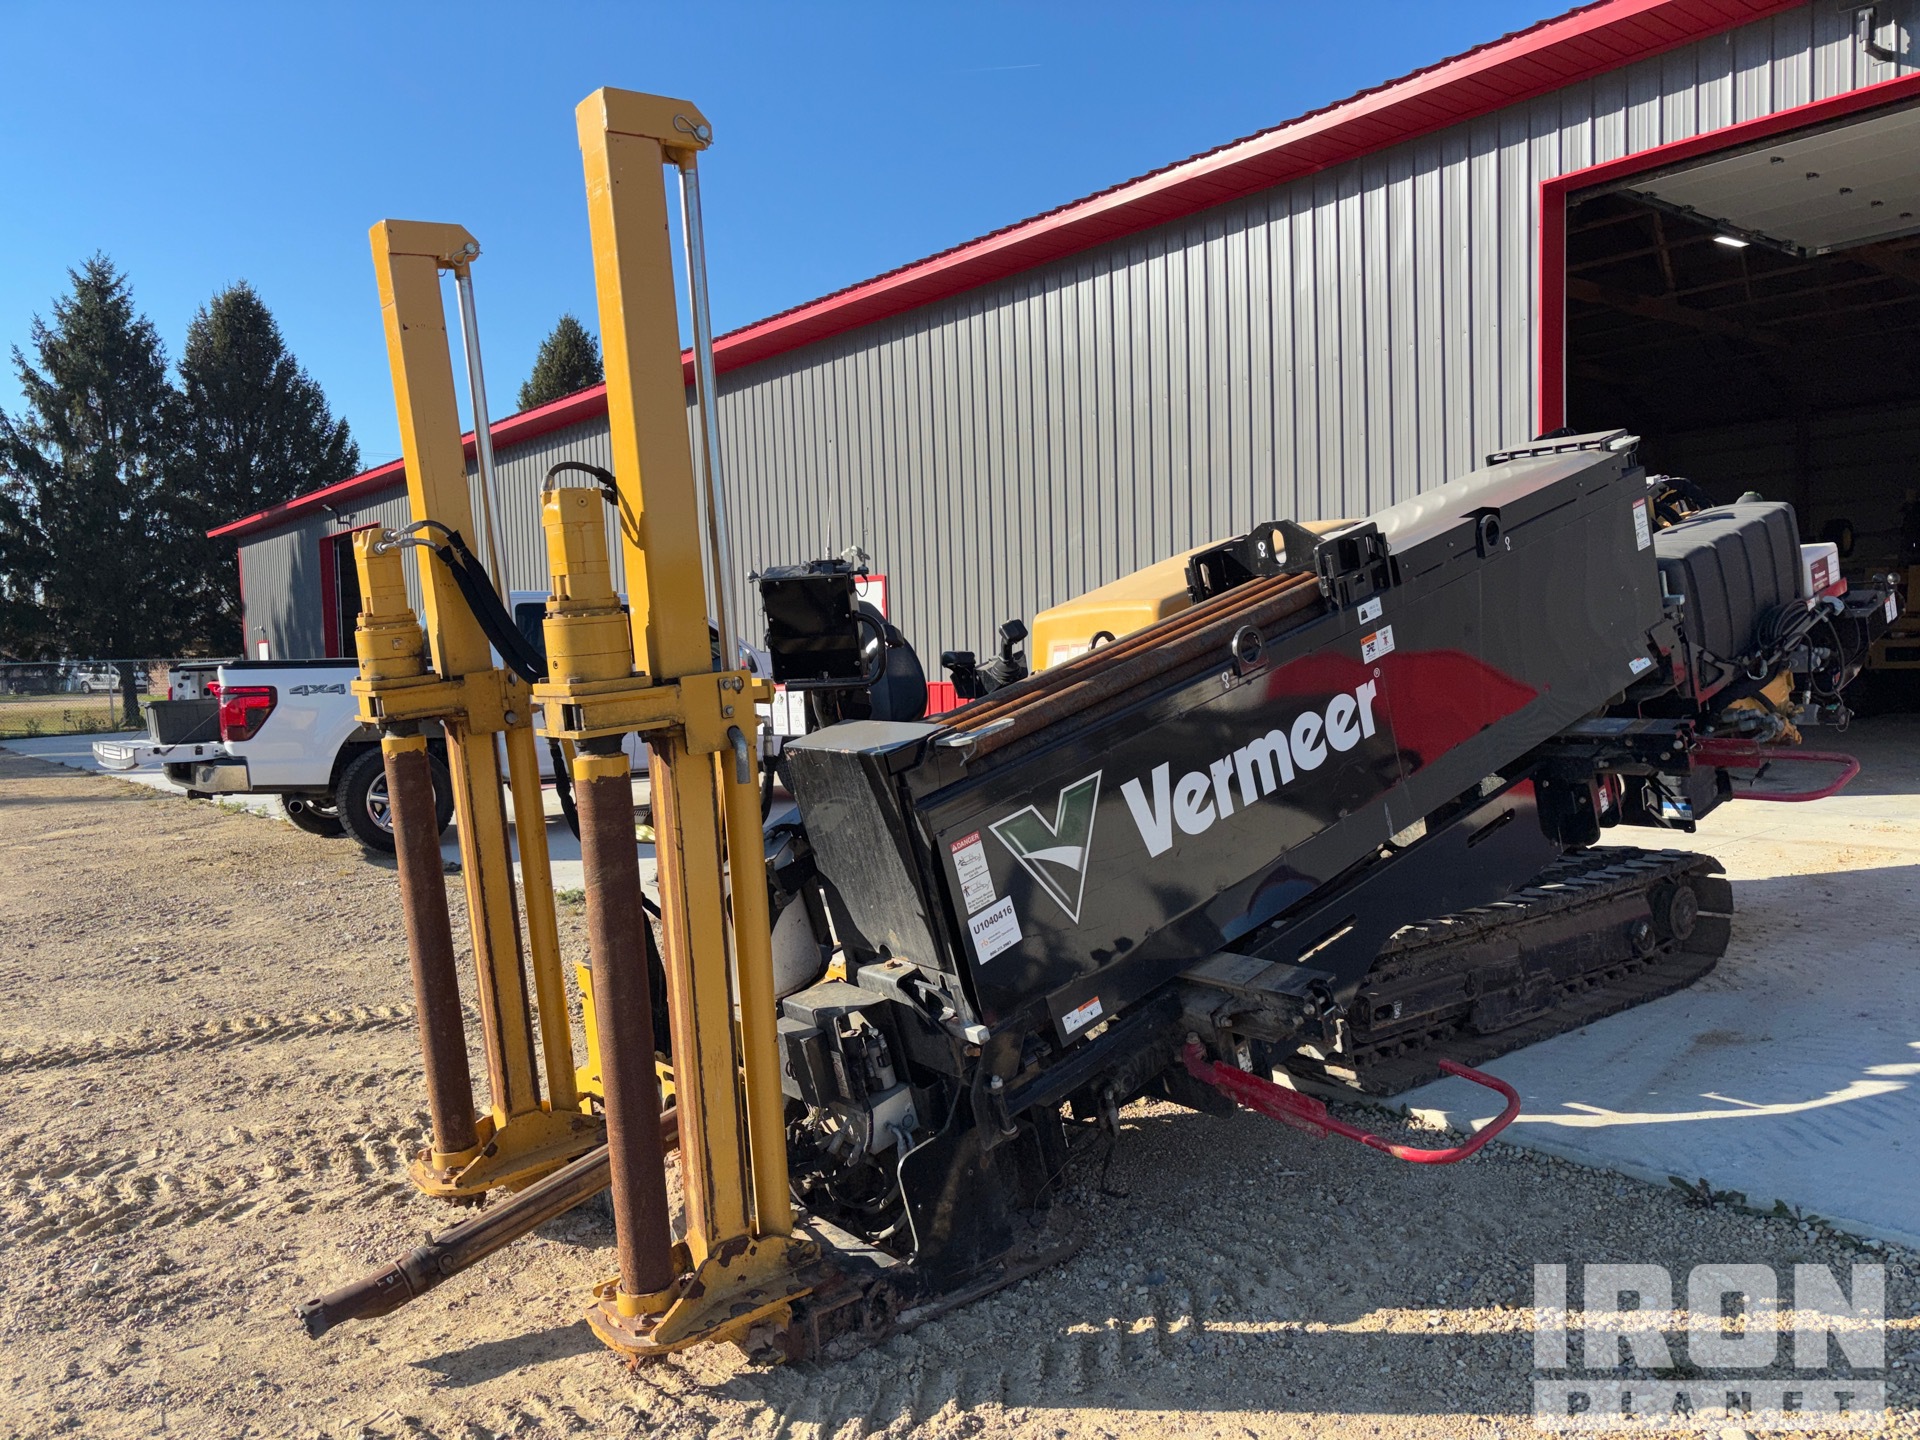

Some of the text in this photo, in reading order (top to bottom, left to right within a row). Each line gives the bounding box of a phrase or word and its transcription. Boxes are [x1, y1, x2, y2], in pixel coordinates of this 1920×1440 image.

[1120, 679, 1377, 858] Vermeer
[956, 833, 980, 849] DANGER
[973, 905, 1013, 935] U1040416
